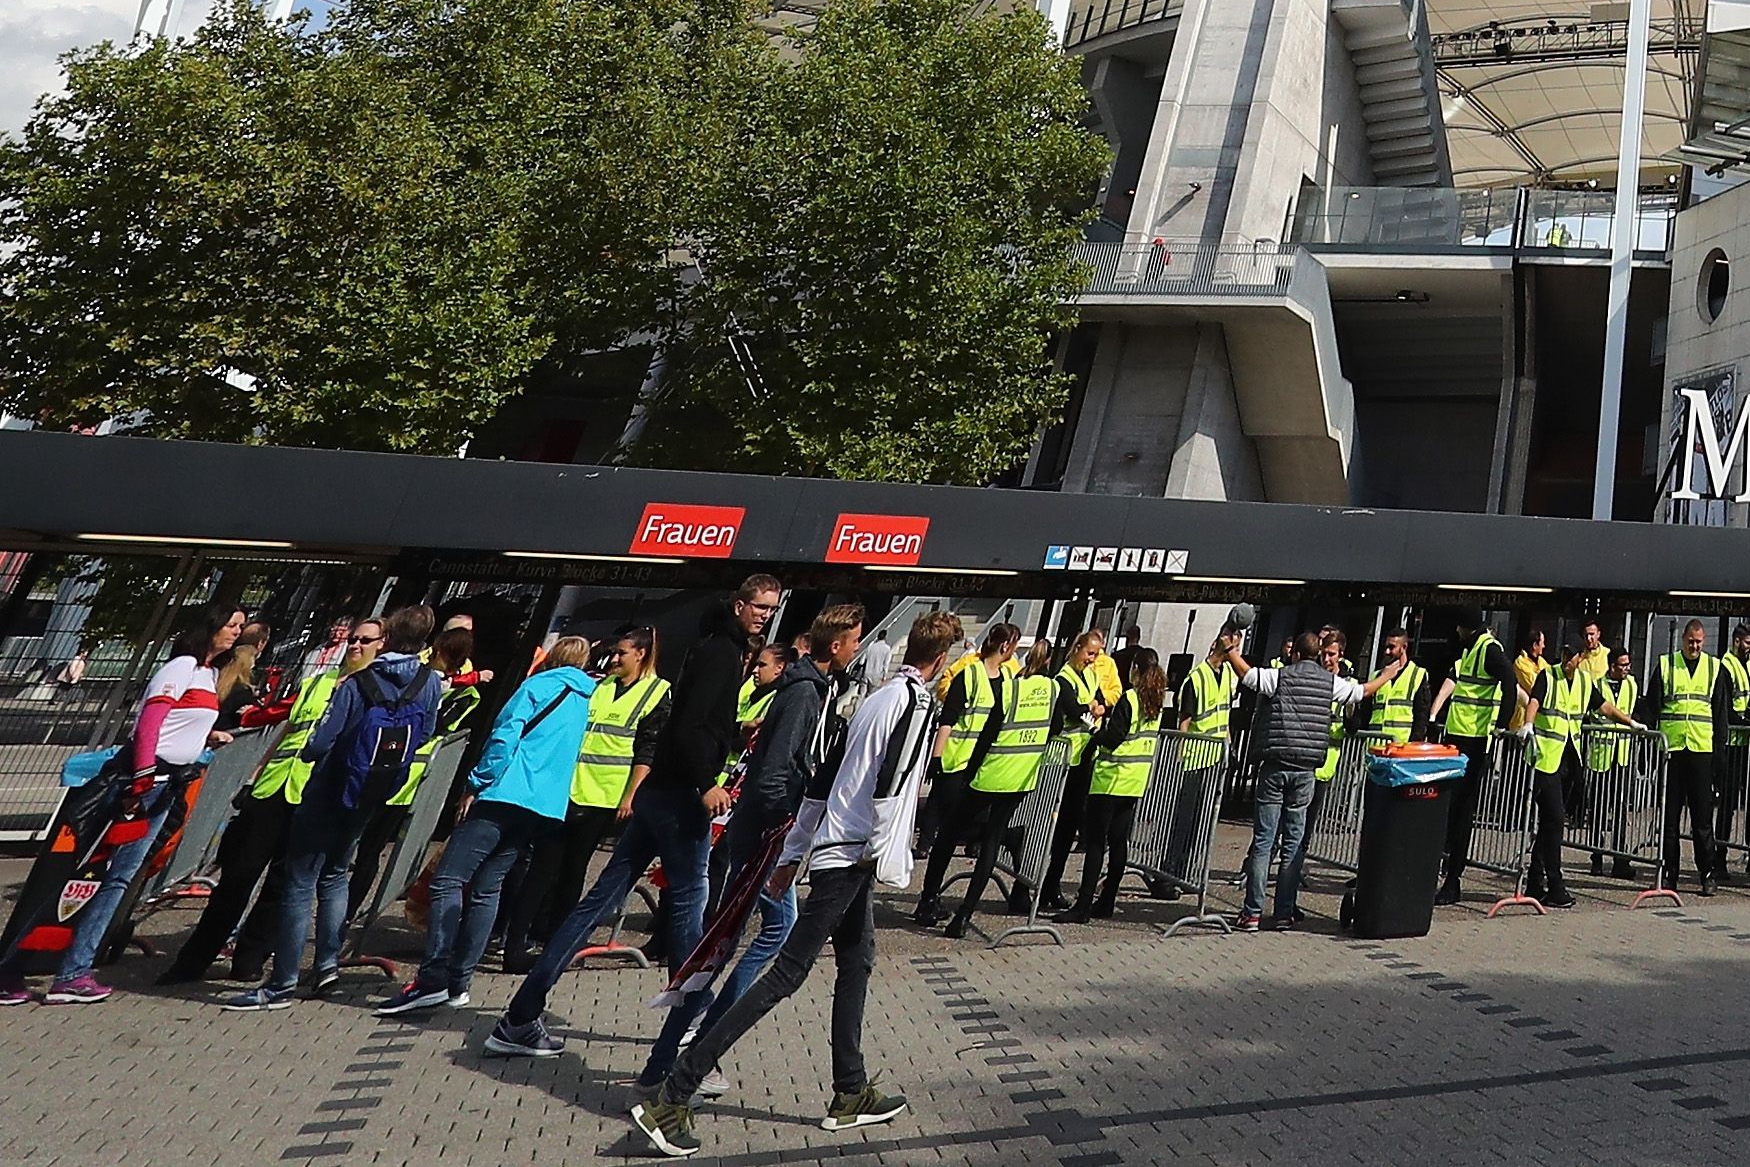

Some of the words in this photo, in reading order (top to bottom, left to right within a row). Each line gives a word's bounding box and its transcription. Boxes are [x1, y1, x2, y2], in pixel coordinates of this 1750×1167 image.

[641, 515, 736, 547] Frauen
[835, 525, 922, 554] Frauen
[516, 562, 556, 577] Kurve
[609, 566, 652, 581] 31-43
[1409, 787, 1435, 797] SULO
